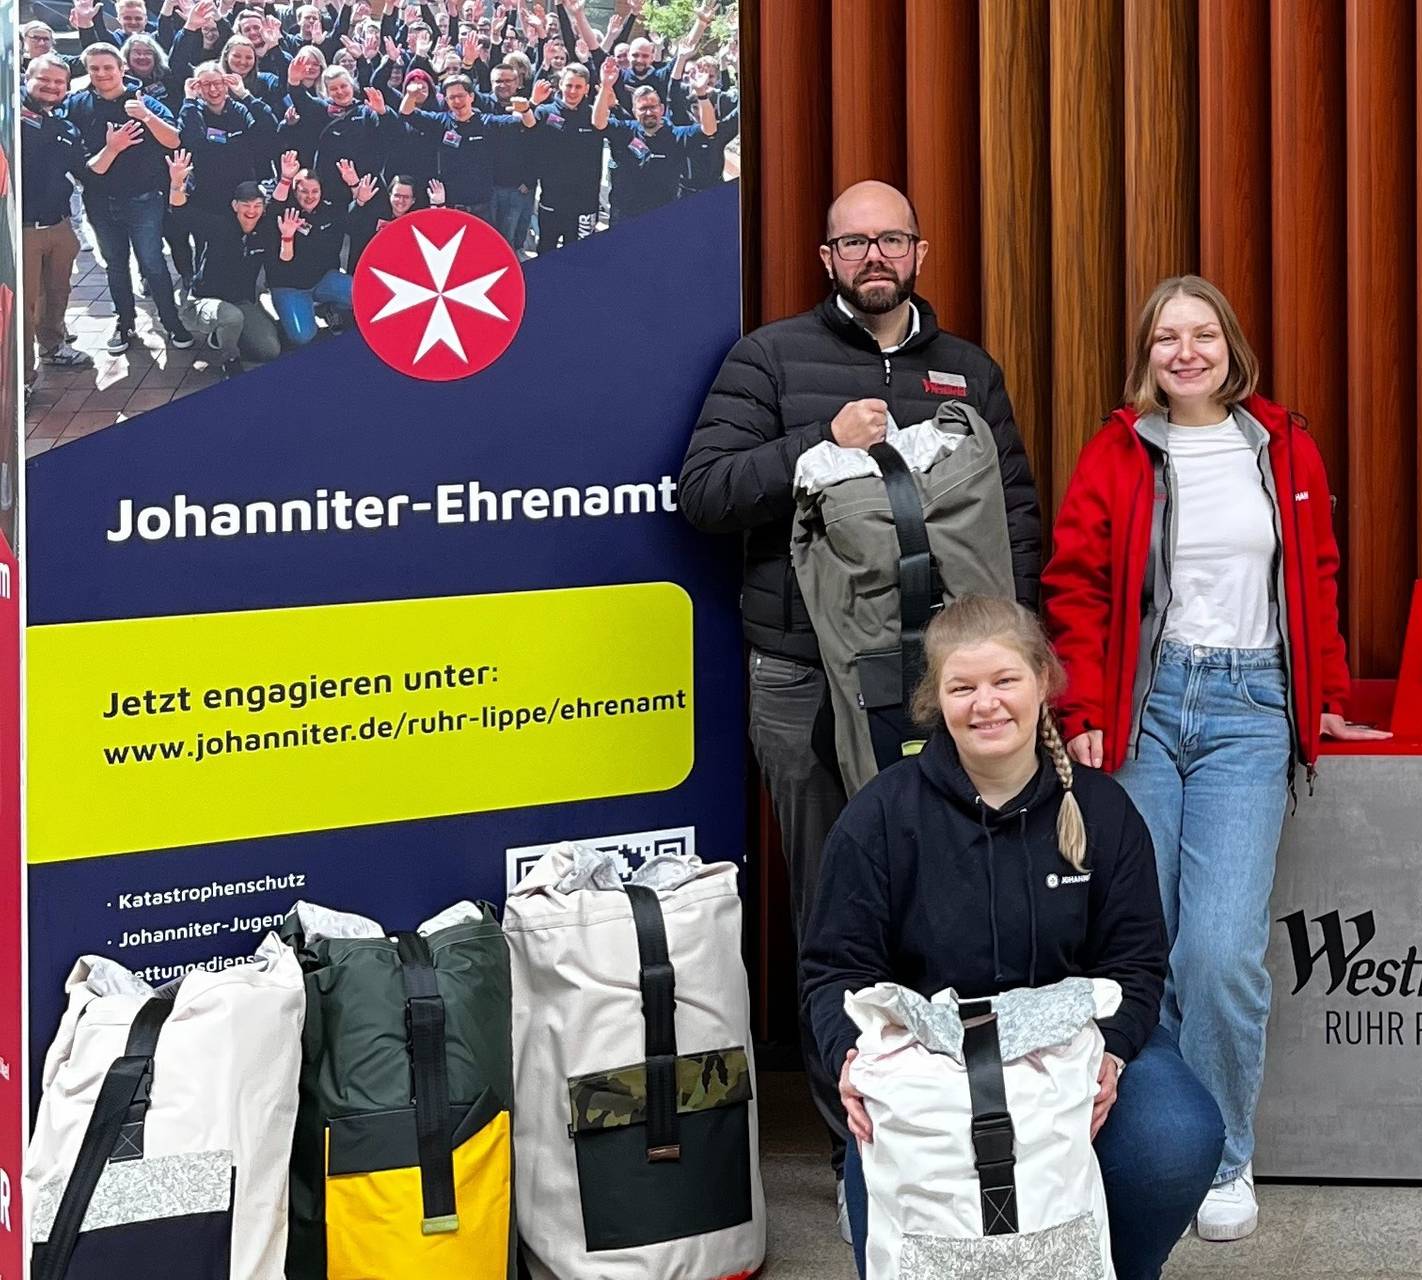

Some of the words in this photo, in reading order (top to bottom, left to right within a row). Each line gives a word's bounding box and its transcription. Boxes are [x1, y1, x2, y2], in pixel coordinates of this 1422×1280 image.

[107, 475, 677, 541] Johanniter-Ehrenamt
[103, 687, 192, 719] Jetzt
[203, 674, 392, 713] engagieren
[403, 664, 499, 692] unter:
[103, 689, 686, 765] www.johanniter.de/ruhr-lippe/ehrenamt
[118, 872, 306, 910] Katastrophenschutz
[118, 911, 289, 948] Johanniter-Jugen
[127, 954, 257, 983] ettunsdiens
[1325, 1010, 1404, 1046] RUHR
